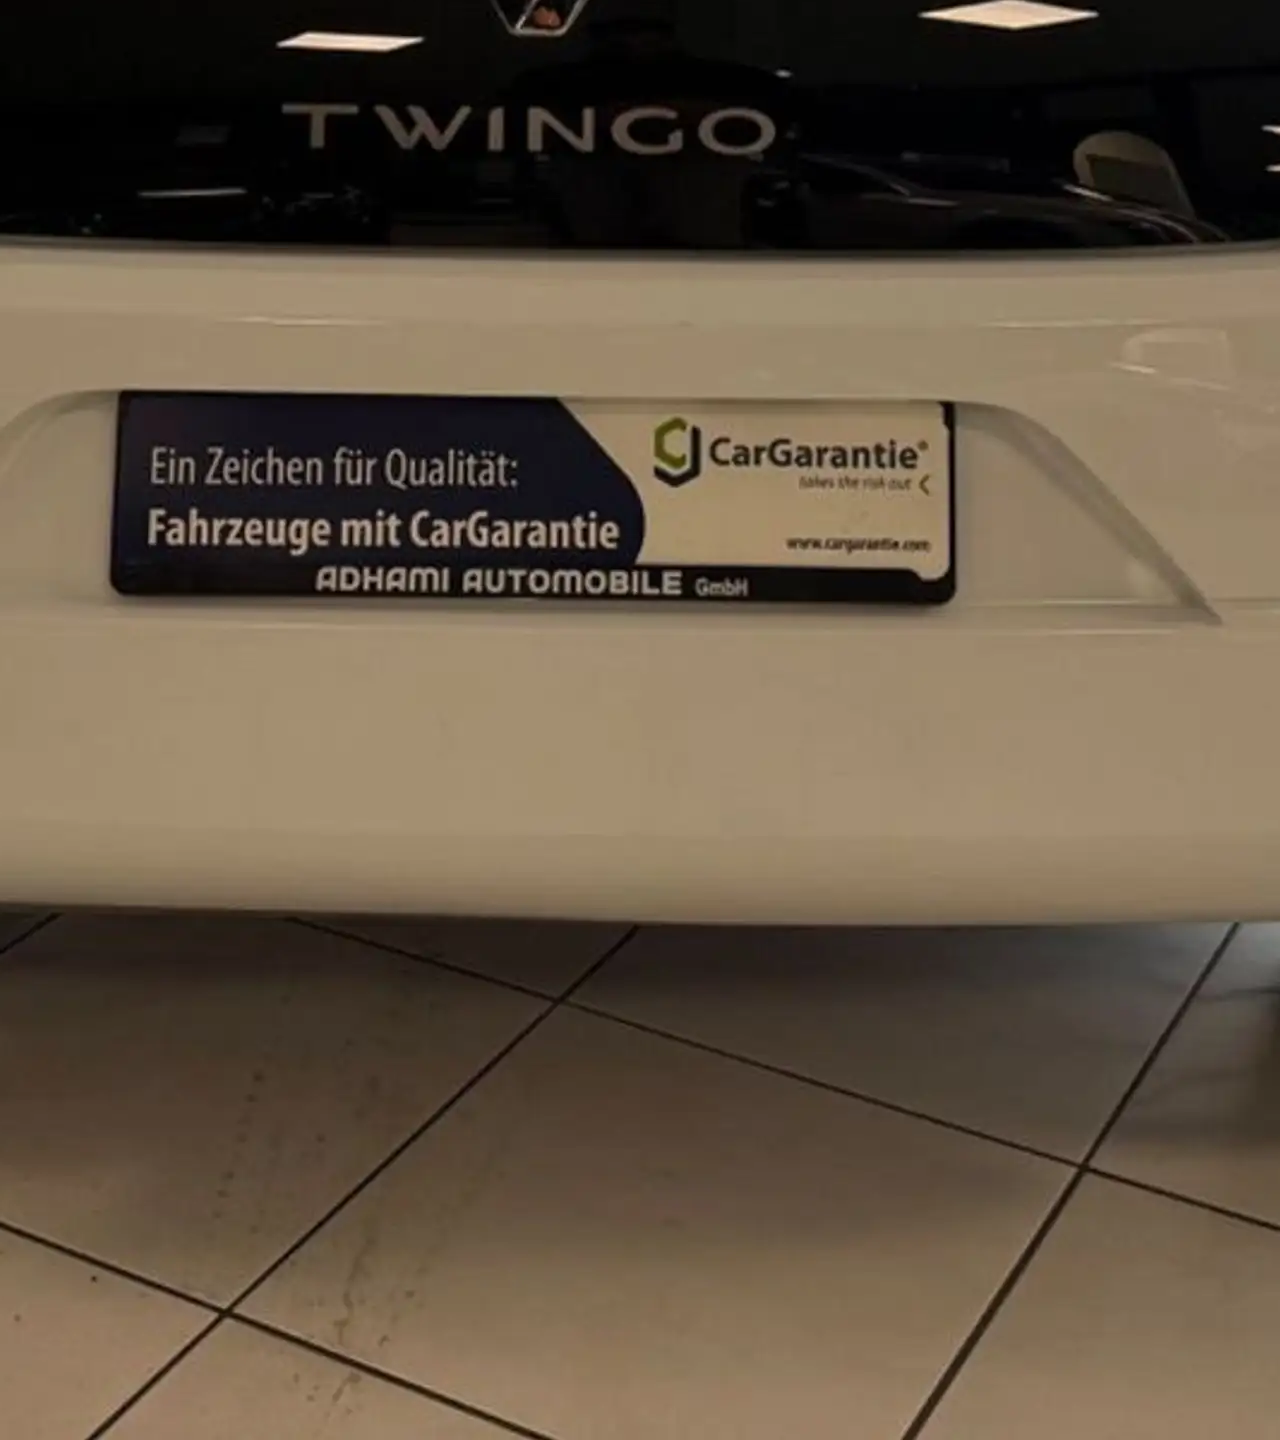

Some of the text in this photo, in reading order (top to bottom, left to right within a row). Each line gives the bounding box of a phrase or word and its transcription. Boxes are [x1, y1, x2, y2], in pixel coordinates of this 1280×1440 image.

[282, 103, 776, 156] TWINGO
[150, 447, 518, 489] Ein Zeichen für Qualität:
[148, 508, 620, 554] Fahrzeuge mit CarGarantie
[786, 537, 932, 554] www.cargarantie.com
[315, 566, 748, 597] ADHAMI AUTOMOBILE GmbH
